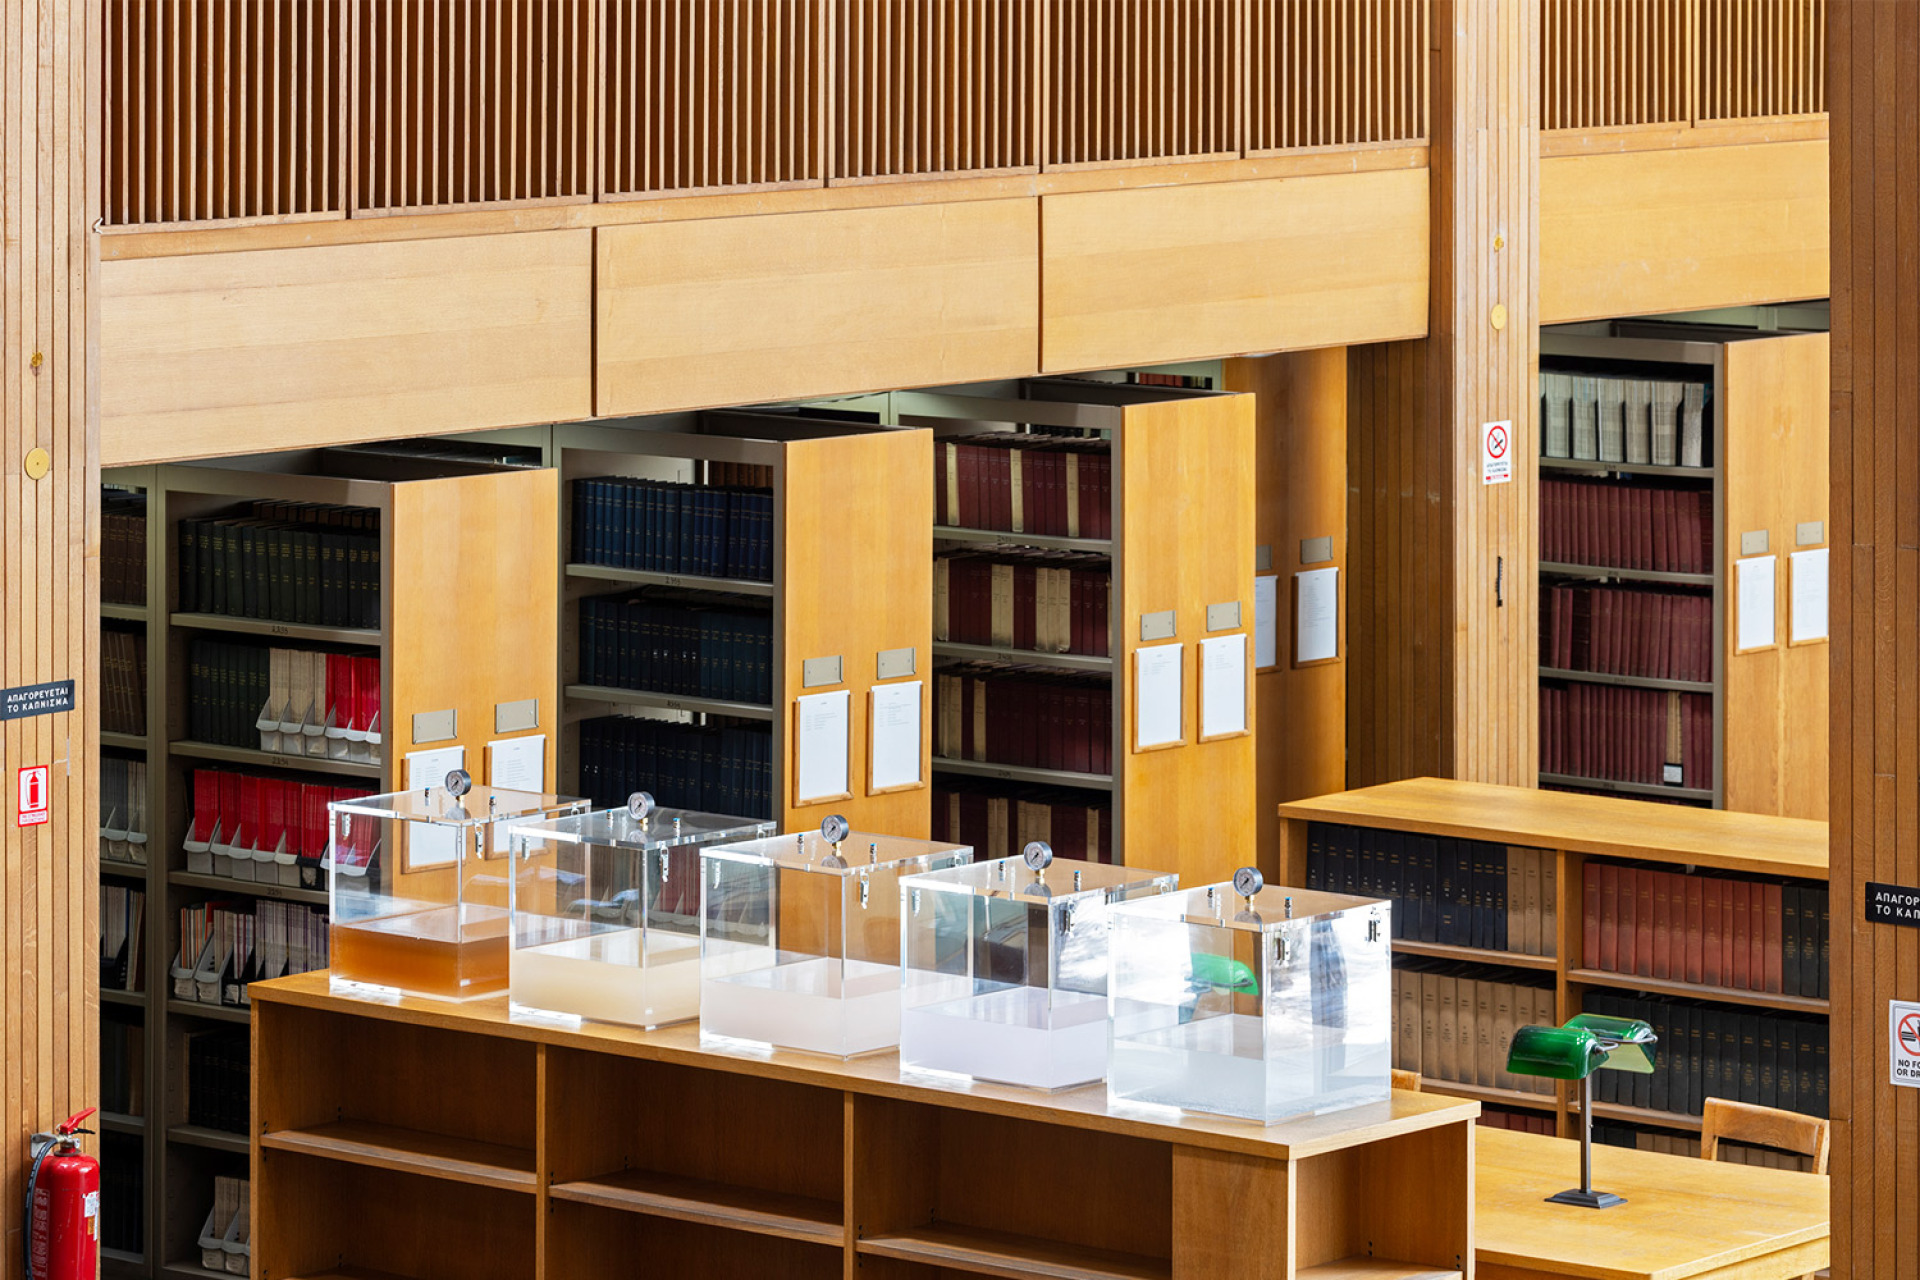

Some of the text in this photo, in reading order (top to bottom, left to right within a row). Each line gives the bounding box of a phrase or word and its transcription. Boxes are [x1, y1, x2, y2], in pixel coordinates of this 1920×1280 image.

[7, 687, 69, 703] ΑΠΑΓΟΡΕΥΕΤΑΙ
[7, 697, 69, 713] ΤΟ ΚΑΠΝΙΣΜΑ
[1875, 891, 1920, 906] ΑΠΑΓΟΡ
[1875, 904, 1891, 916] ΤΟ
[1897, 1059, 1910, 1067] NO
[1896, 1068, 1907, 1076] OR
